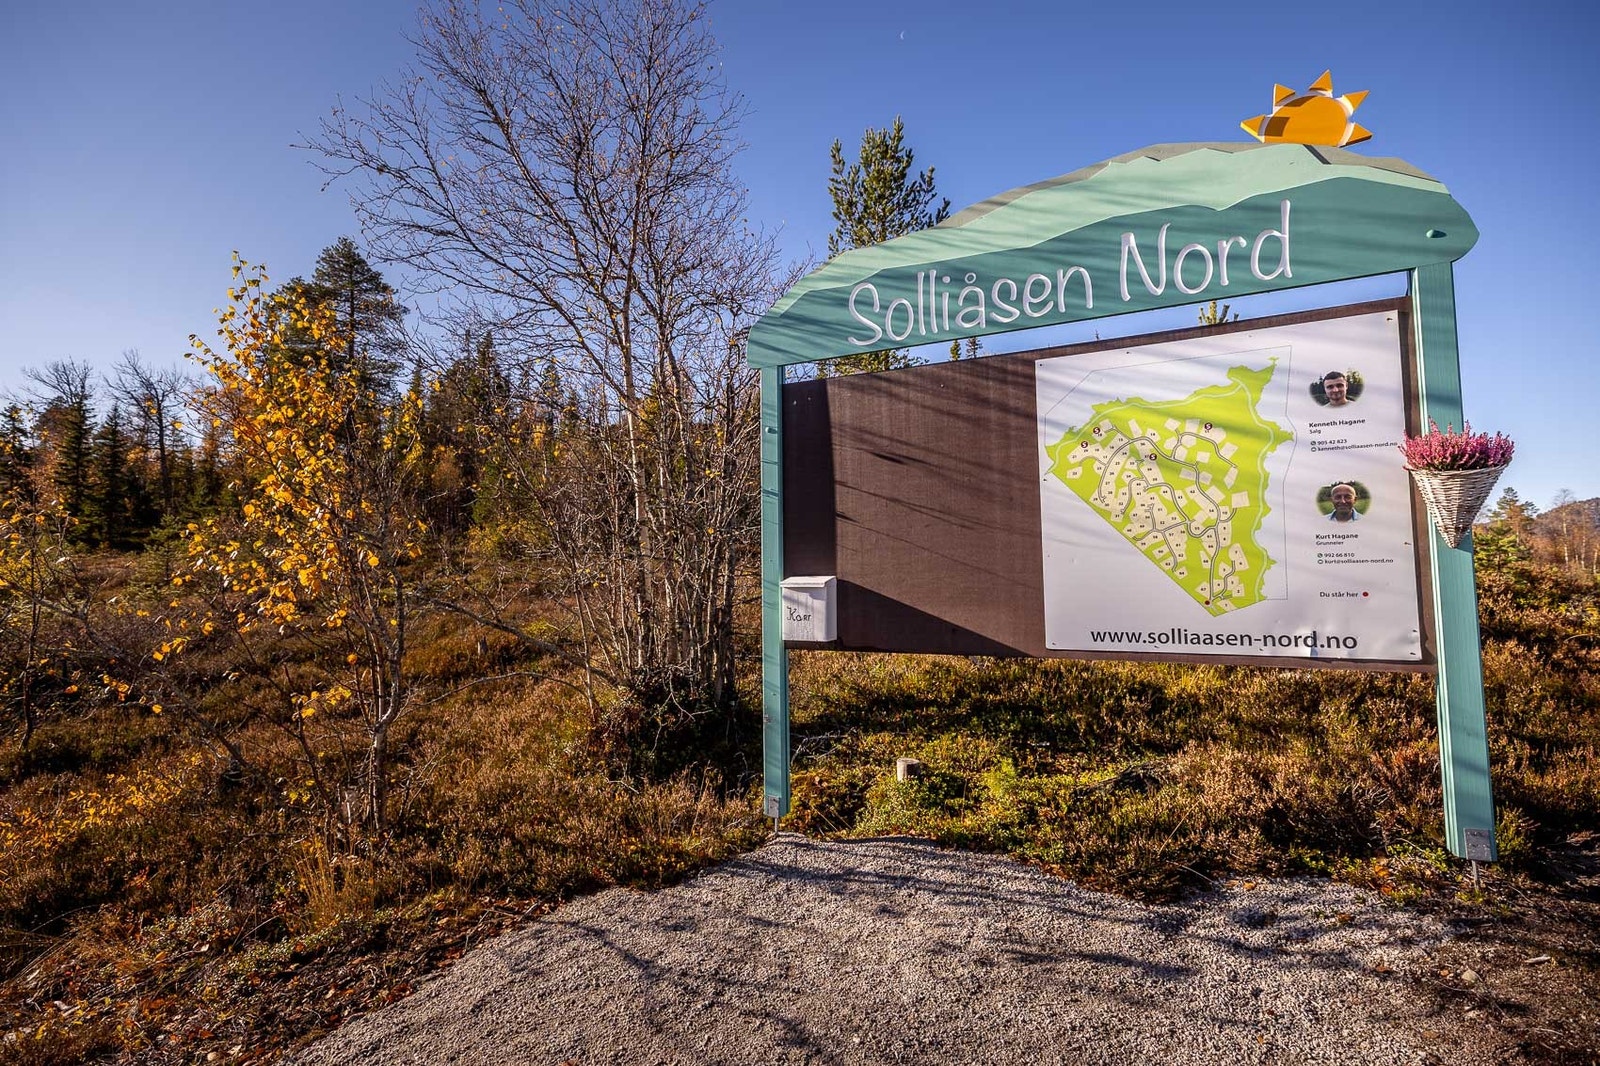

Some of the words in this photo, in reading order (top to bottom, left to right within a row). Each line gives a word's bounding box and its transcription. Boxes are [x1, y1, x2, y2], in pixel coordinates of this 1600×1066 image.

[848, 265, 1094, 346] Solliåsen
[1120, 199, 1292, 302] Nord
[1308, 420, 1338, 428] Kenneth
[1338, 418, 1366, 426] Hagane
[1331, 533, 1359, 541] Hagane
[1331, 590, 1345, 598] står
[1090, 627, 1358, 650] www.solliaasen-nord.no
